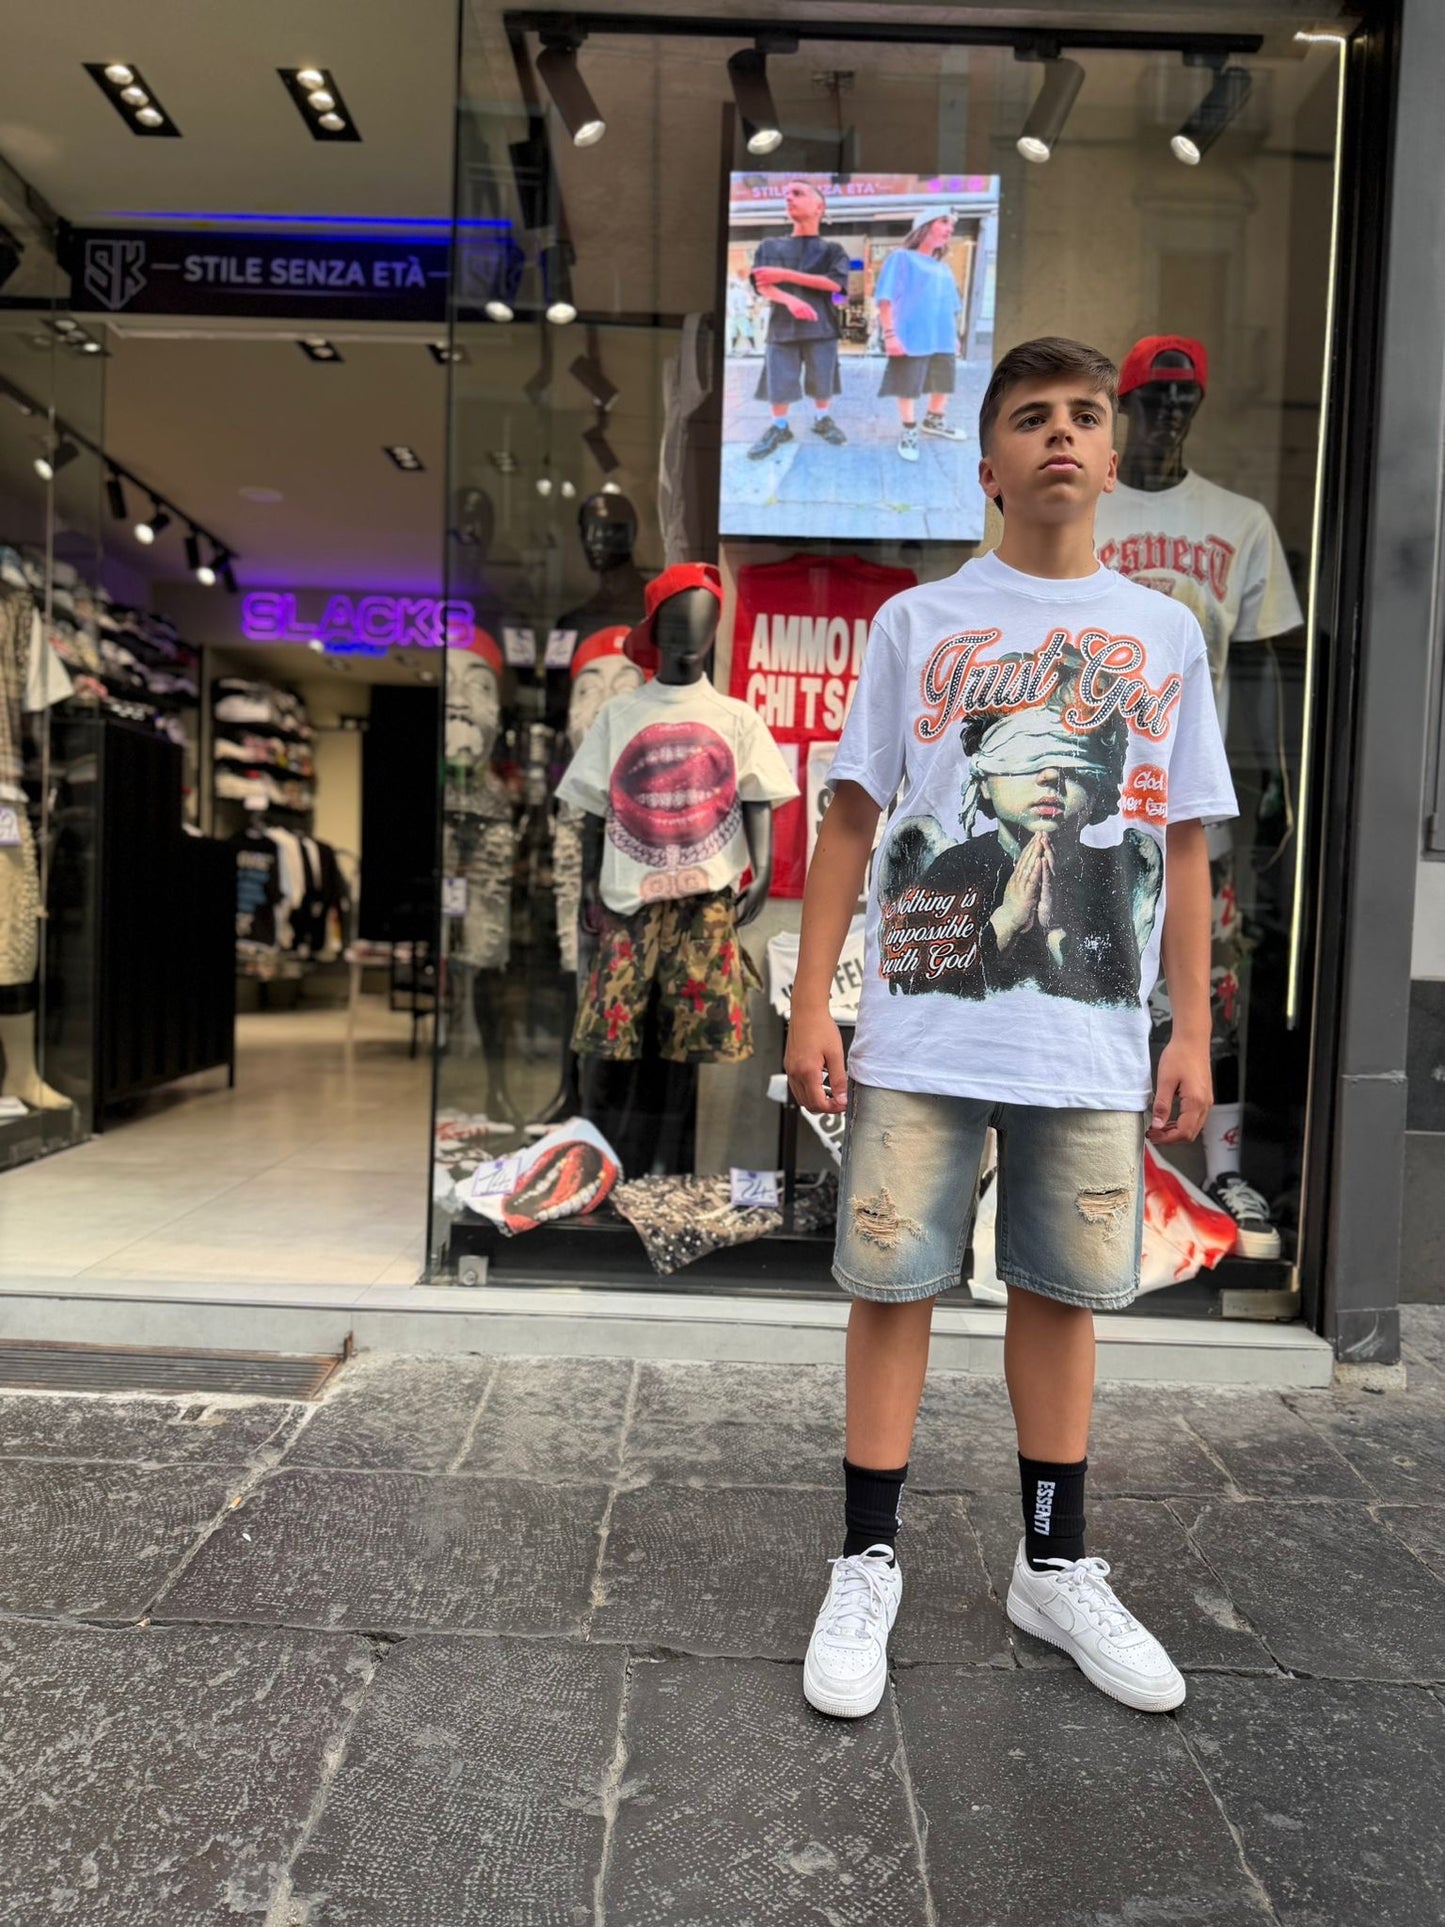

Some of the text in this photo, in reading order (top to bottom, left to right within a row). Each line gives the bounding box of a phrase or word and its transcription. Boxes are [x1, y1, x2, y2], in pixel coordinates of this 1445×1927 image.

[184, 254, 426, 288] STILE SENZA ETÀ
[241, 592, 475, 648] SLACKS
[919, 632, 1182, 738] Trust God
[960, 887, 977, 908] is
[886, 914, 975, 952] impossible
[882, 942, 977, 980] with God
